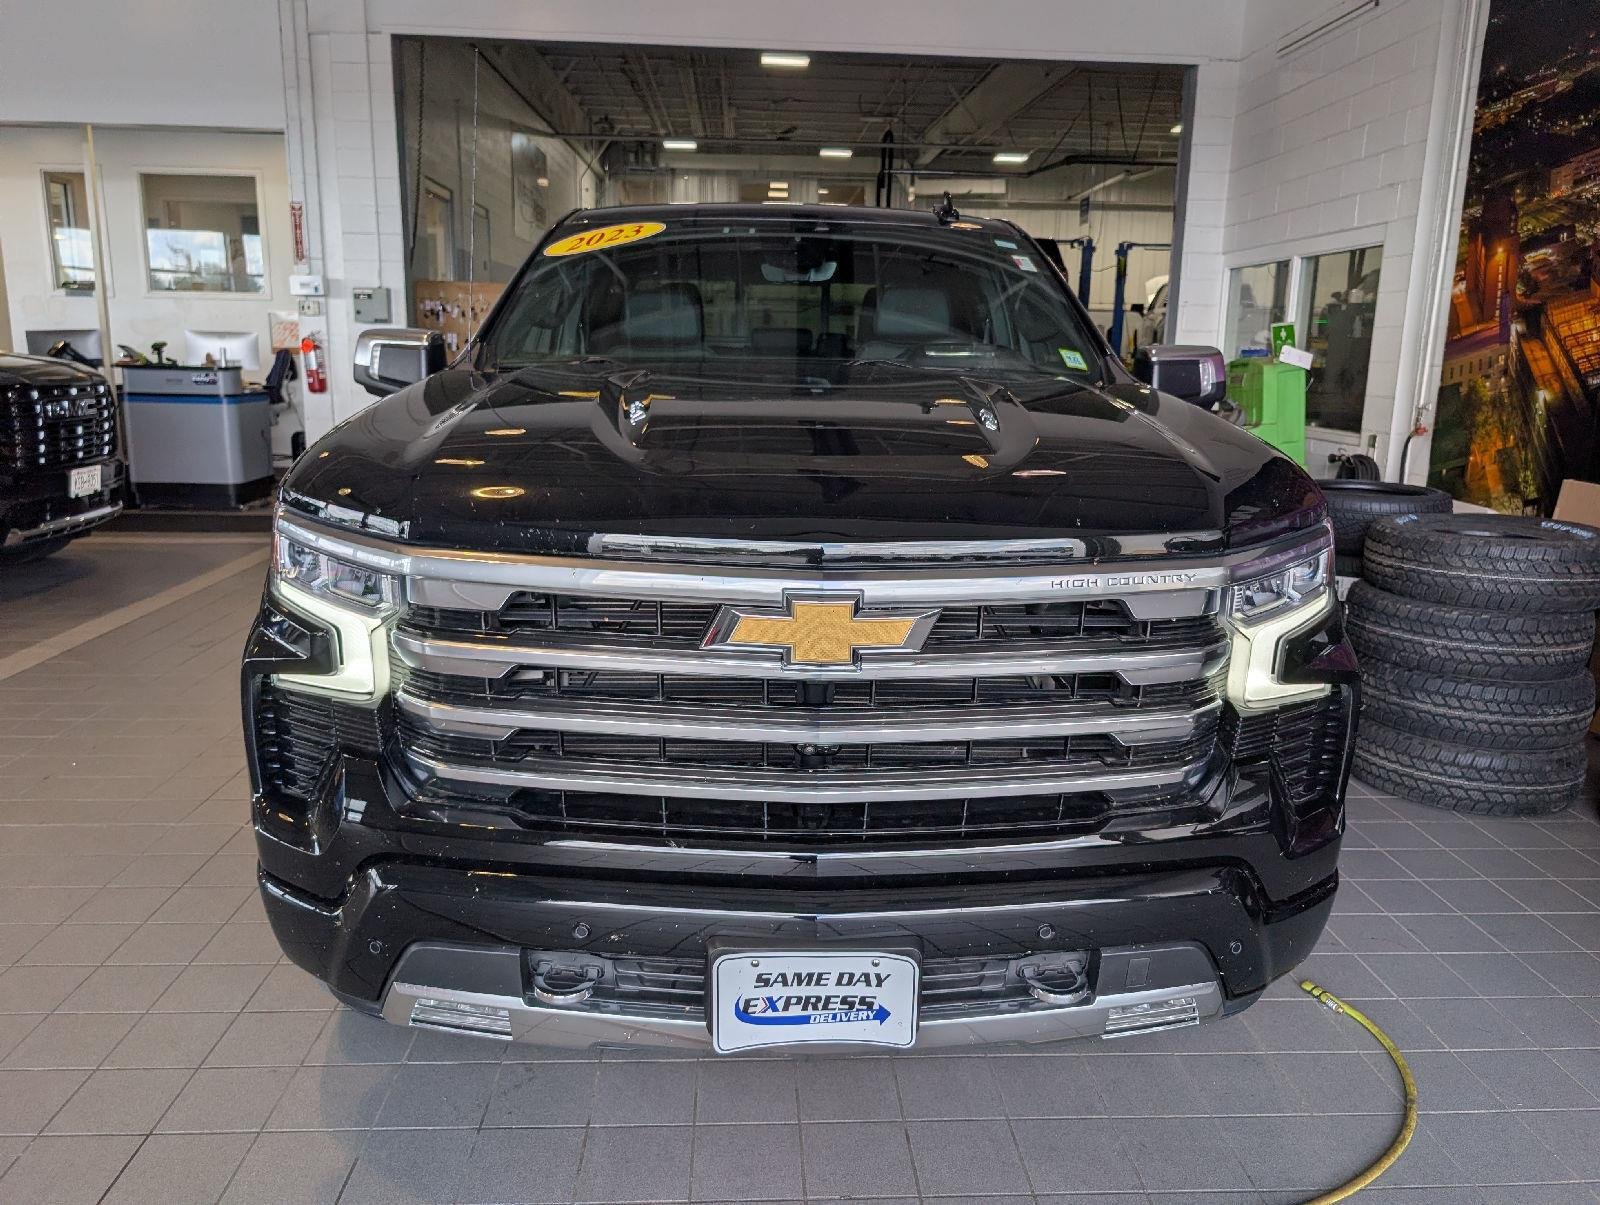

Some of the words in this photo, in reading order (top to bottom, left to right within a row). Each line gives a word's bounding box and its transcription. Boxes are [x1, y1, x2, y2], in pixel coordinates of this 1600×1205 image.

[565, 224, 645, 253] 2023
[1051, 578, 1098, 589] HIGH
[1107, 572, 1198, 587] COUNTRY
[753, 971, 832, 989] SAME
[834, 971, 892, 988] DAY
[742, 994, 878, 1014] EXPRESS
[809, 1010, 877, 1024] DELIVERY
